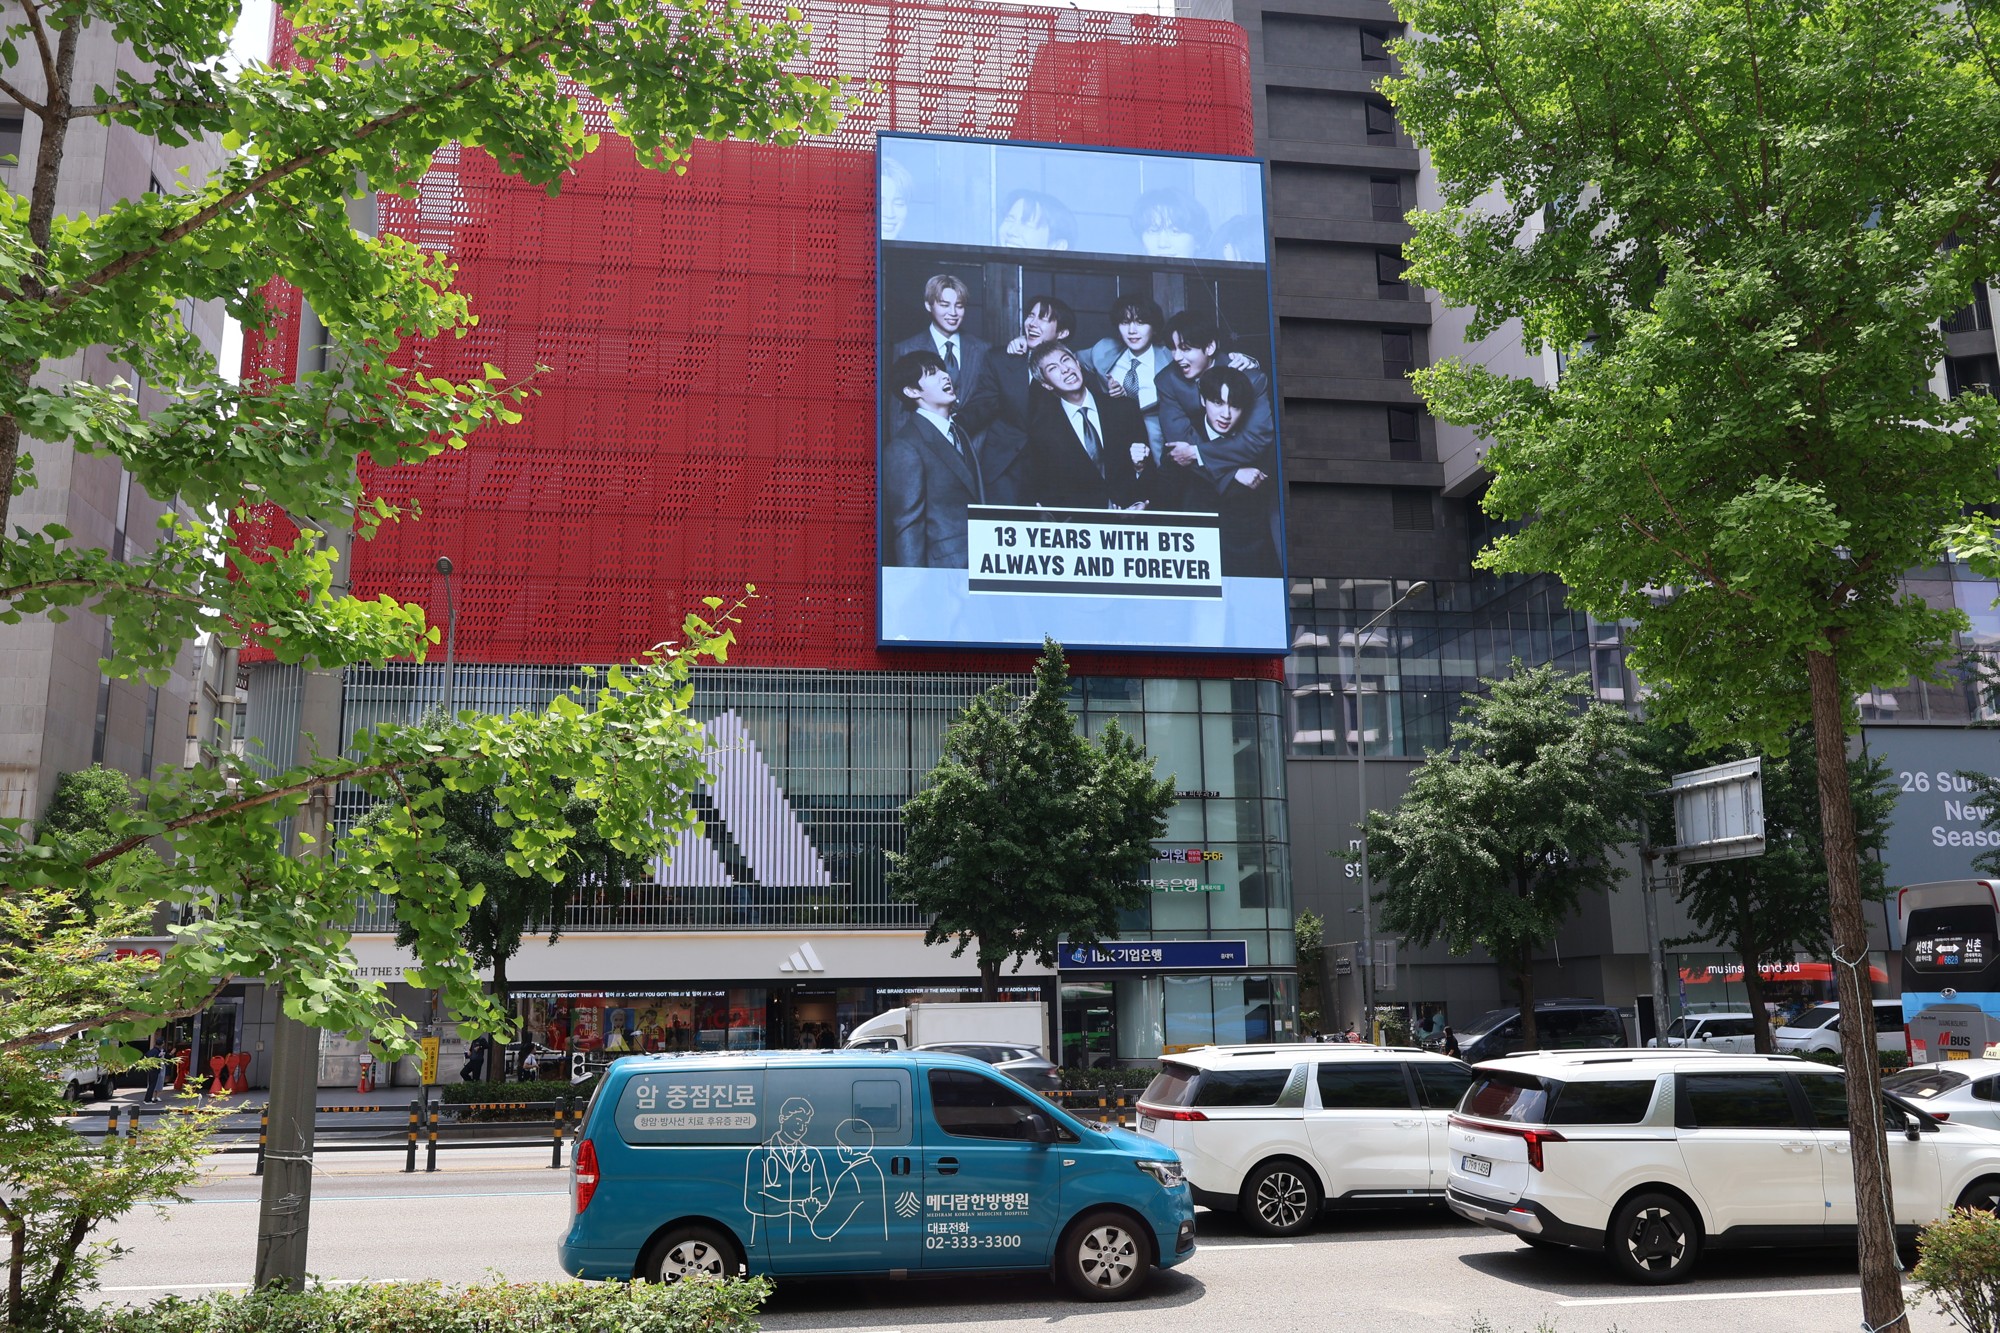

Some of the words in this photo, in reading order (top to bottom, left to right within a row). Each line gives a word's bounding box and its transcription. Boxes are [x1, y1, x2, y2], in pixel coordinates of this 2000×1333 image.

[994, 526, 1017, 547] 13
[1026, 527, 1091, 549] YEARS
[1100, 530, 1149, 551] WITH
[1158, 532, 1195, 552] BTS
[980, 553, 1065, 576] ALWAYS
[1073, 556, 1114, 577] AND
[1124, 558, 1210, 580] FOREVER
[1900, 772, 1930, 792] 26
[1936, 772, 2000, 793] Su
[1151, 849, 1186, 864] 의원
[1915, 940, 1933, 954] 서인천
[1965, 938, 1982, 952] 신촌
[1118, 949, 1163, 962] 기업은행
[349, 967, 368, 977] ITH
[371, 967, 392, 977] THE
[394, 967, 401, 976] 3
[1708, 963, 1745, 974] musins
[1757, 962, 1800, 973] tandard
[636, 1085, 659, 1109] 암
[666, 1085, 756, 1109] 중점진료
[688, 1116, 705, 1126] 치료
[707, 1116, 732, 1126] 후유증
[734, 1116, 751, 1126] 관리
[926, 1192, 1029, 1211] 메디람한방병원
[927, 1222, 970, 1235] 대표전화
[926, 1235, 1021, 1249] 02-333-3300
